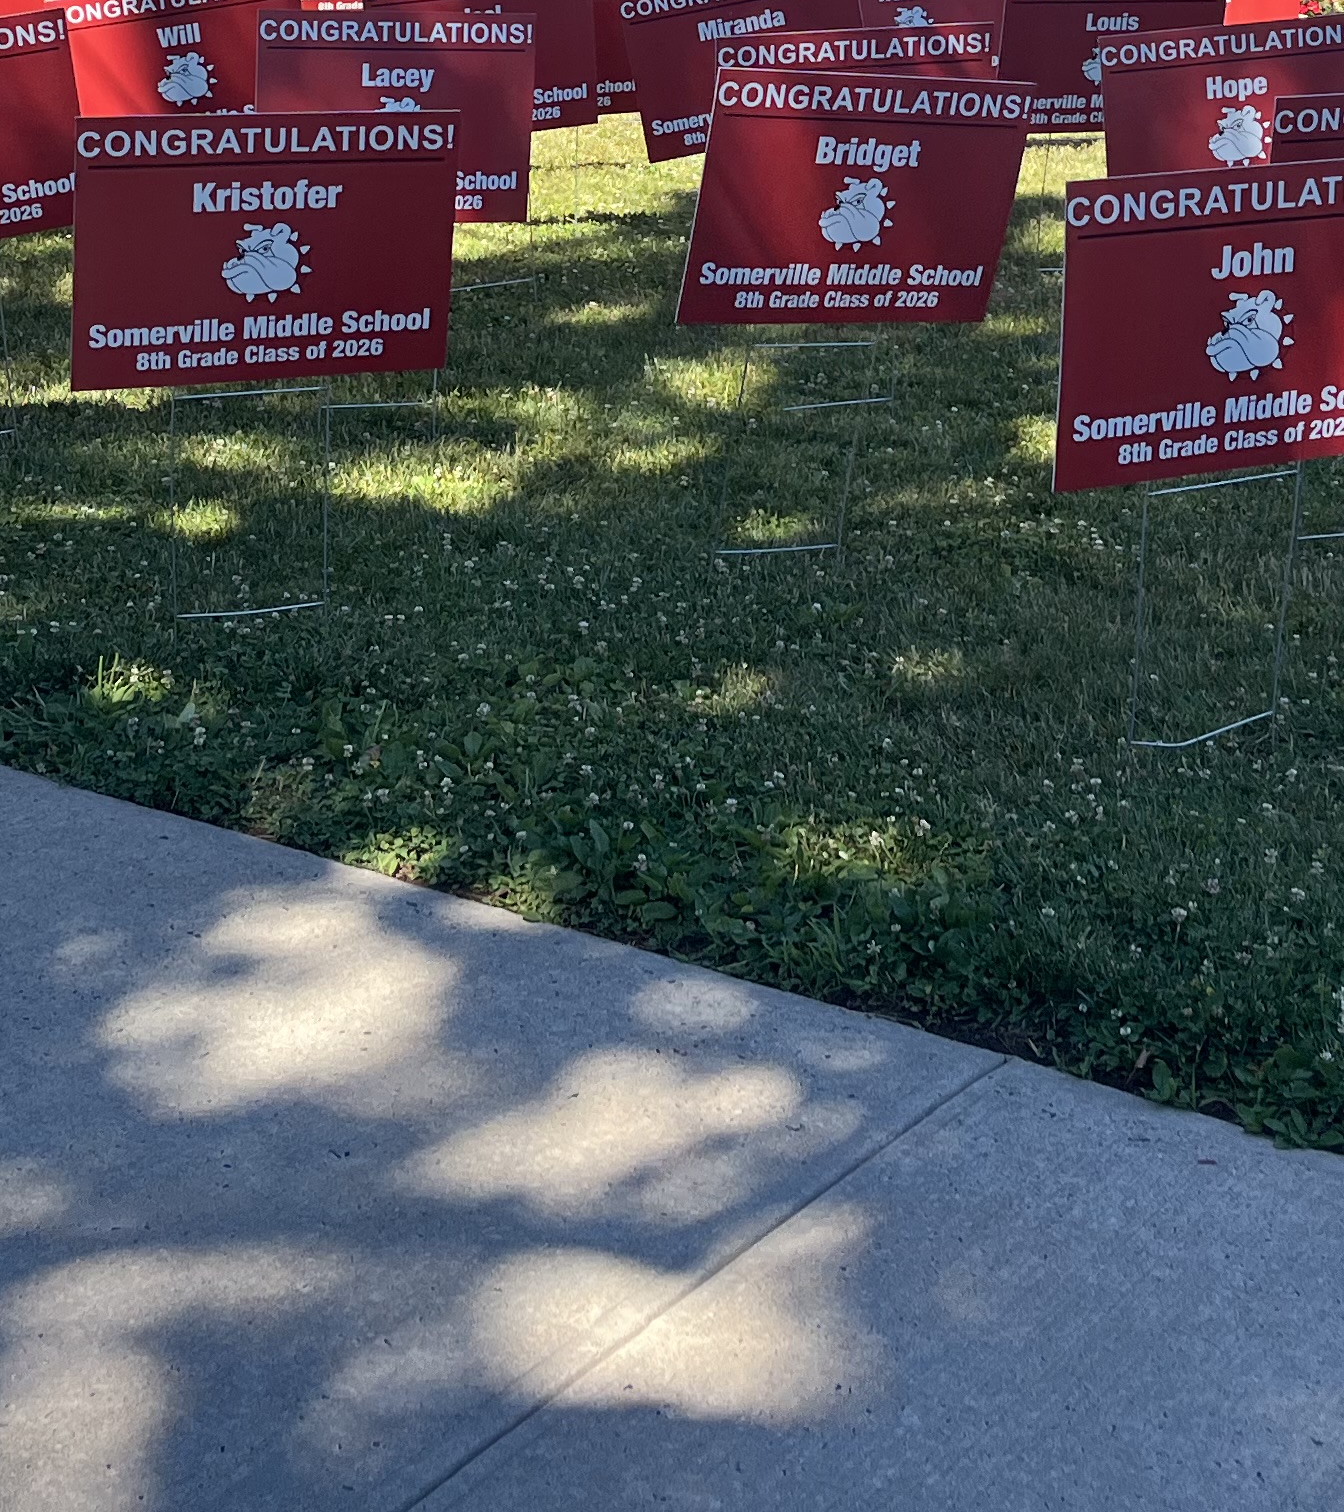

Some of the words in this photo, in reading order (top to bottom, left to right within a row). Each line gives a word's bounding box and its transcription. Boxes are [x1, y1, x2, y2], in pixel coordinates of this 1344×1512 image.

[156, 23, 201, 48] Will
[260, 20, 532, 43] CONGRATULATIONS!
[698, 9, 788, 44] Miranda
[1086, 13, 1139, 31] Louis
[718, 33, 989, 66] CONGRATULATIONS!
[362, 63, 434, 92] Lacey
[1207, 76, 1267, 101] Hope
[533, 83, 587, 104] School
[719, 81, 1031, 119] CONGRATULATIONS!
[1052, 112, 1087, 123] Grade
[77, 125, 454, 157] CONGRATULATIONS!
[815, 136, 921, 172] Bridget
[2, 173, 75, 208] School
[193, 179, 342, 212] Kristofer
[0, 204, 42, 224] 2026
[700, 262, 821, 285] Somerville
[826, 264, 901, 285] Middle
[907, 264, 983, 286] School
[1211, 242, 1294, 279] John
[735, 291, 764, 308] 8th
[769, 291, 819, 308] Grade
[824, 291, 869, 307] Class
[874, 291, 893, 307] of
[895, 291, 939, 307] 2026
[89, 319, 235, 348] Somerville
[243, 313, 333, 339] Middle
[342, 308, 430, 333] School
[136, 352, 170, 370] 8th
[178, 348, 238, 368] Grade
[245, 345, 299, 363] Class
[306, 341, 326, 359] of
[332, 339, 383, 357] 2026
[1073, 402, 1216, 441] Somerville
[1224, 390, 1312, 423] Middle
[1118, 442, 1152, 464] 8th
[1159, 434, 1218, 459] Grade
[1224, 430, 1278, 450] Class
[1284, 422, 1305, 443] of
